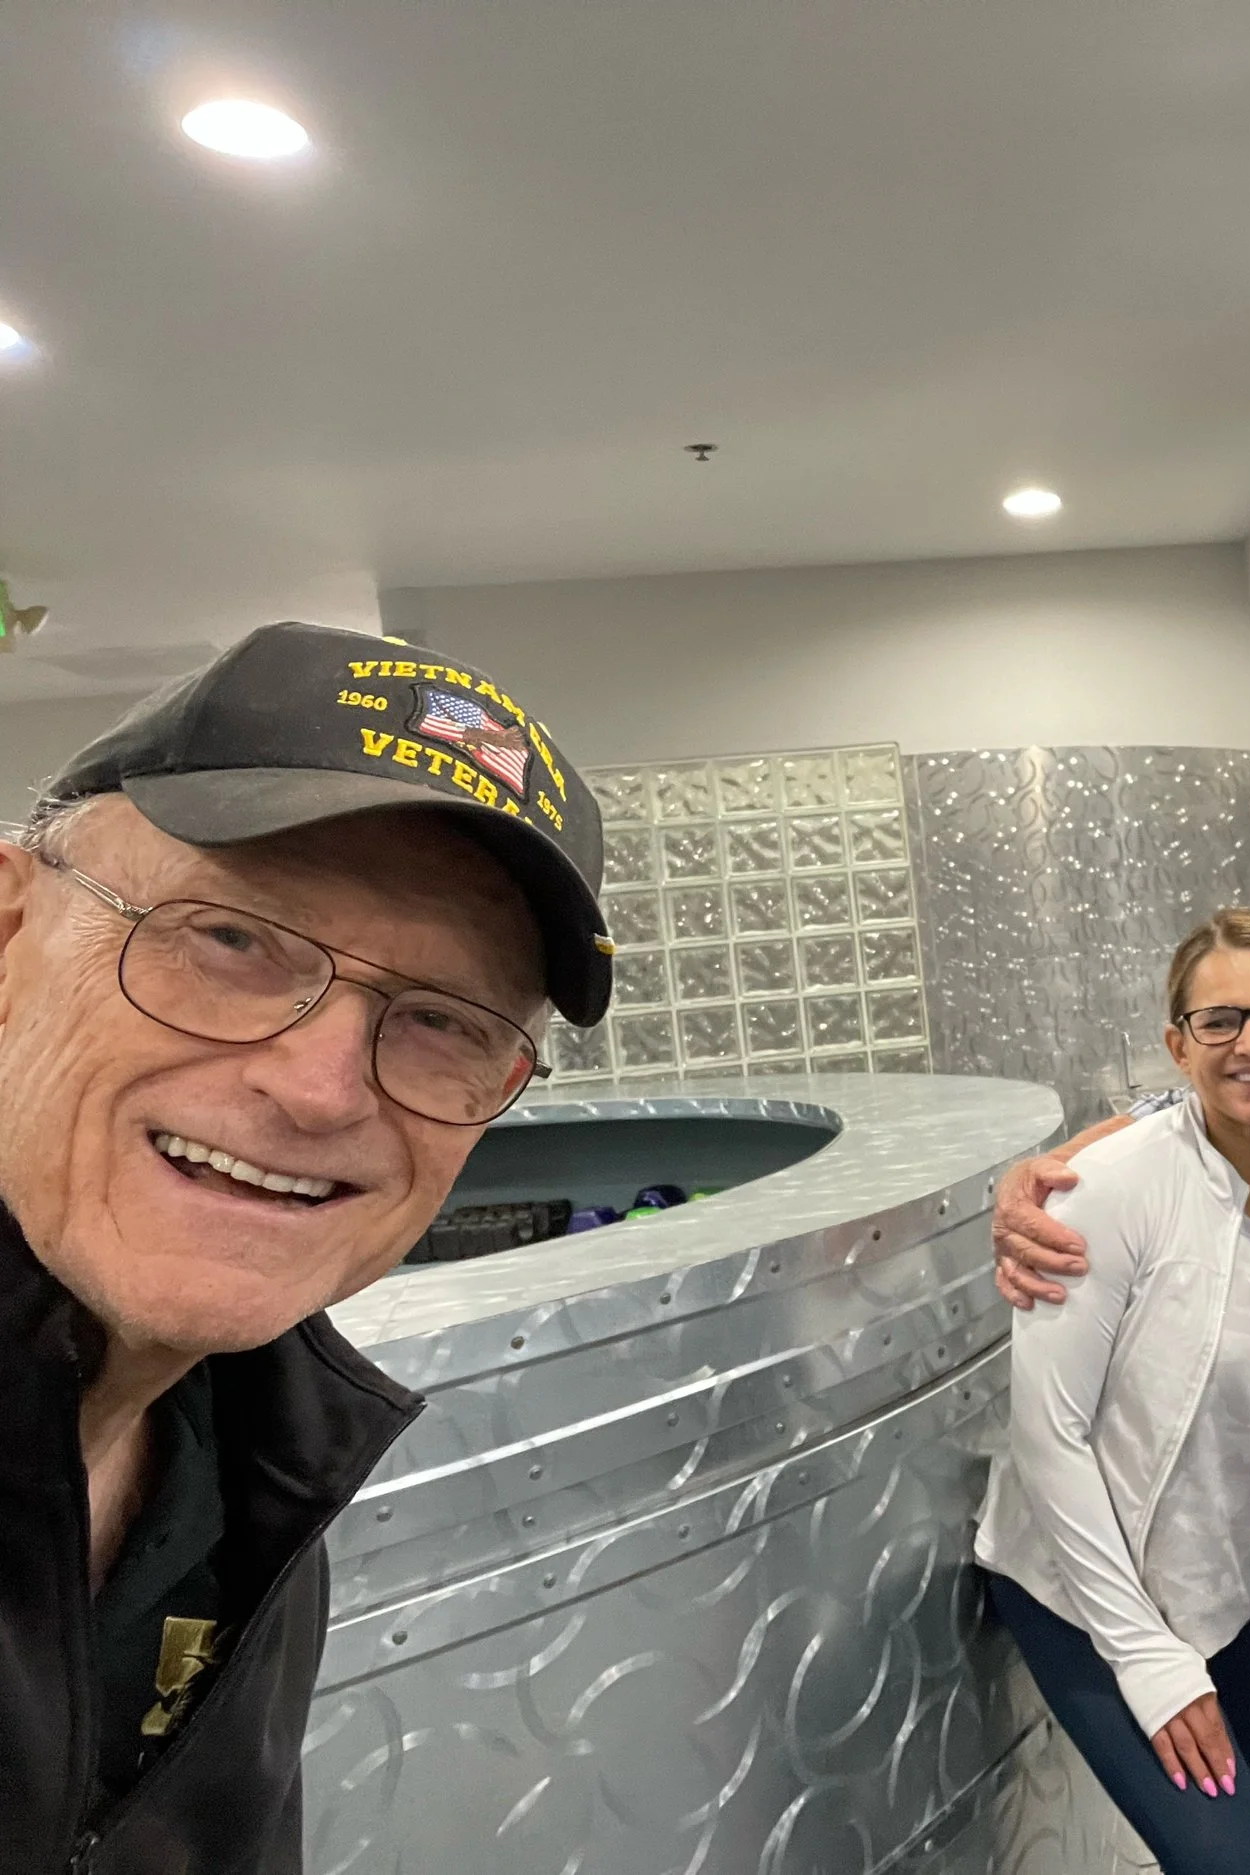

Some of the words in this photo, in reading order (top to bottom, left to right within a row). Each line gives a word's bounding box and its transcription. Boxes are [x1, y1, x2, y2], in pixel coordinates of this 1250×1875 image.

[337, 689, 388, 711] 1960
[348, 660, 525, 727] VIETNAM
[360, 728, 533, 825] VETERA
[537, 790, 563, 831] 1975
